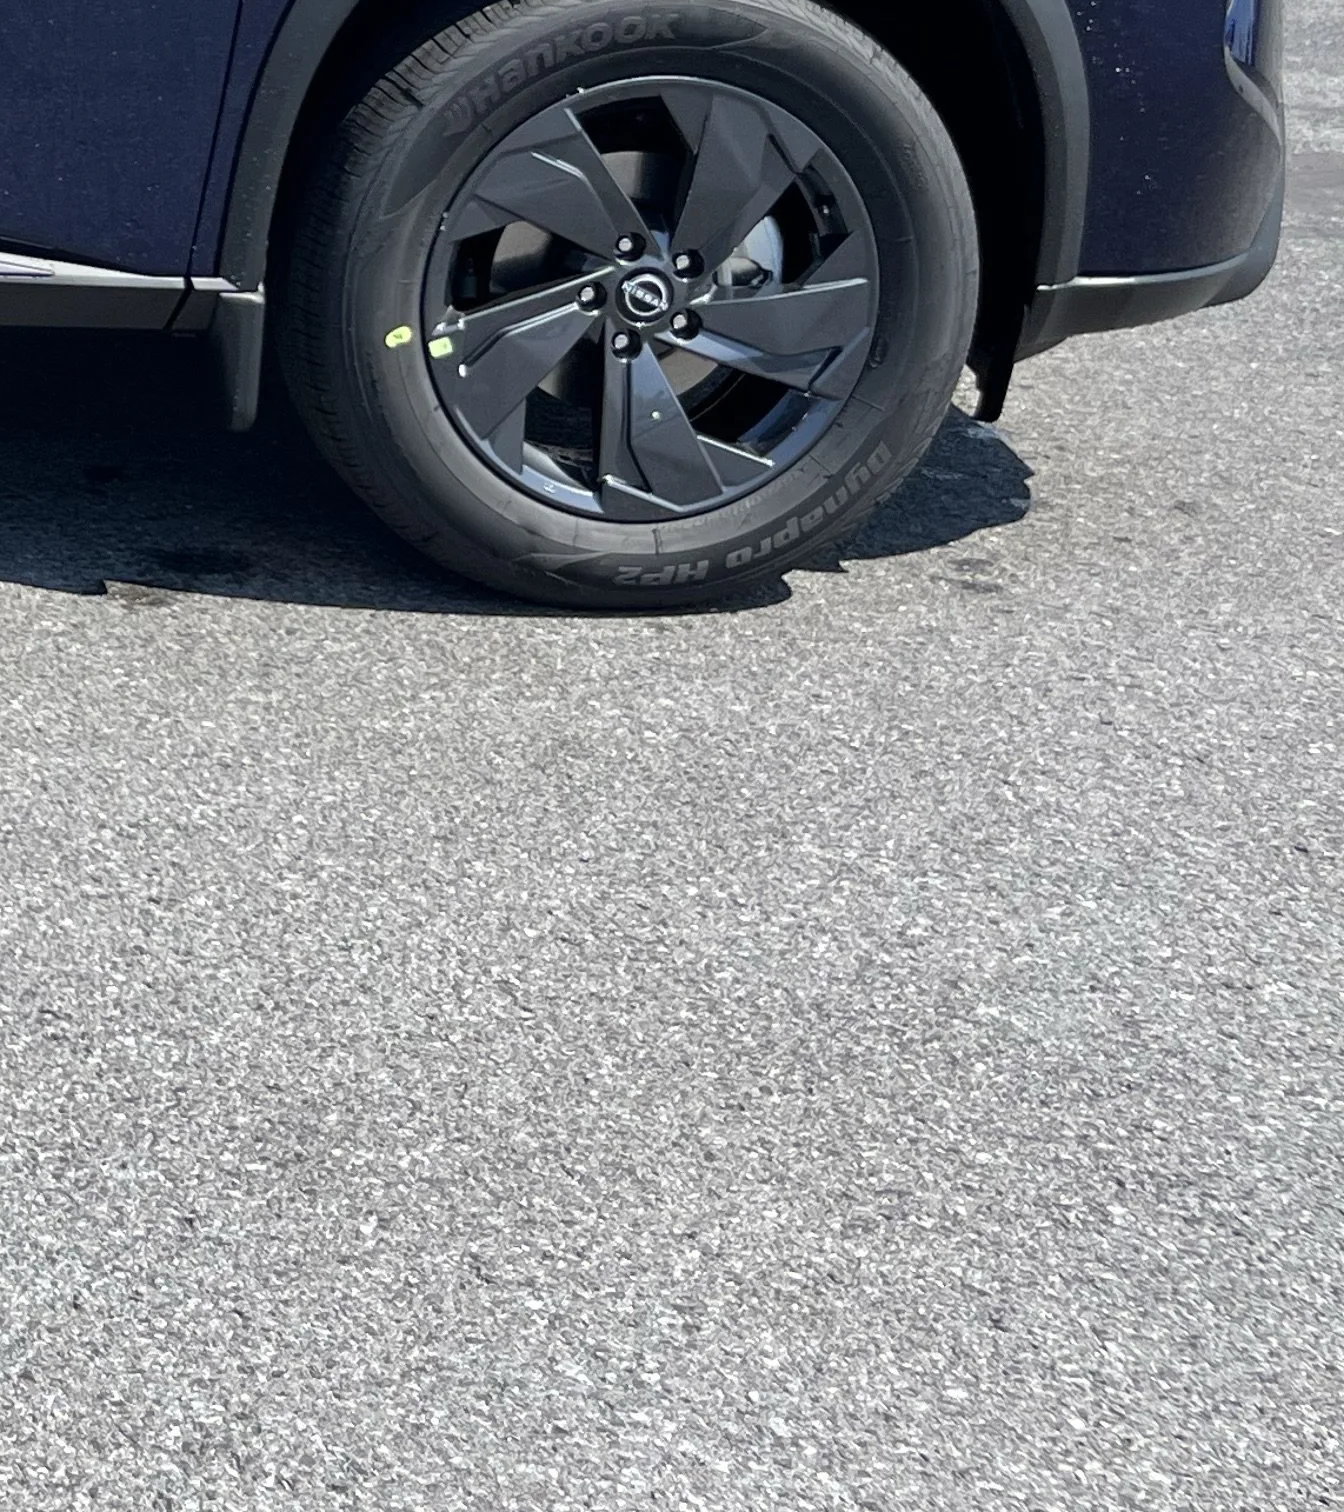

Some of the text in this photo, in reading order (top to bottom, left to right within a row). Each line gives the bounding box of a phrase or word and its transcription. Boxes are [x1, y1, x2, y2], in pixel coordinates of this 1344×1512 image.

[621, 280, 669, 312] NISSAN
[725, 439, 894, 569] Dynapro
[614, 559, 710, 587] HP2
